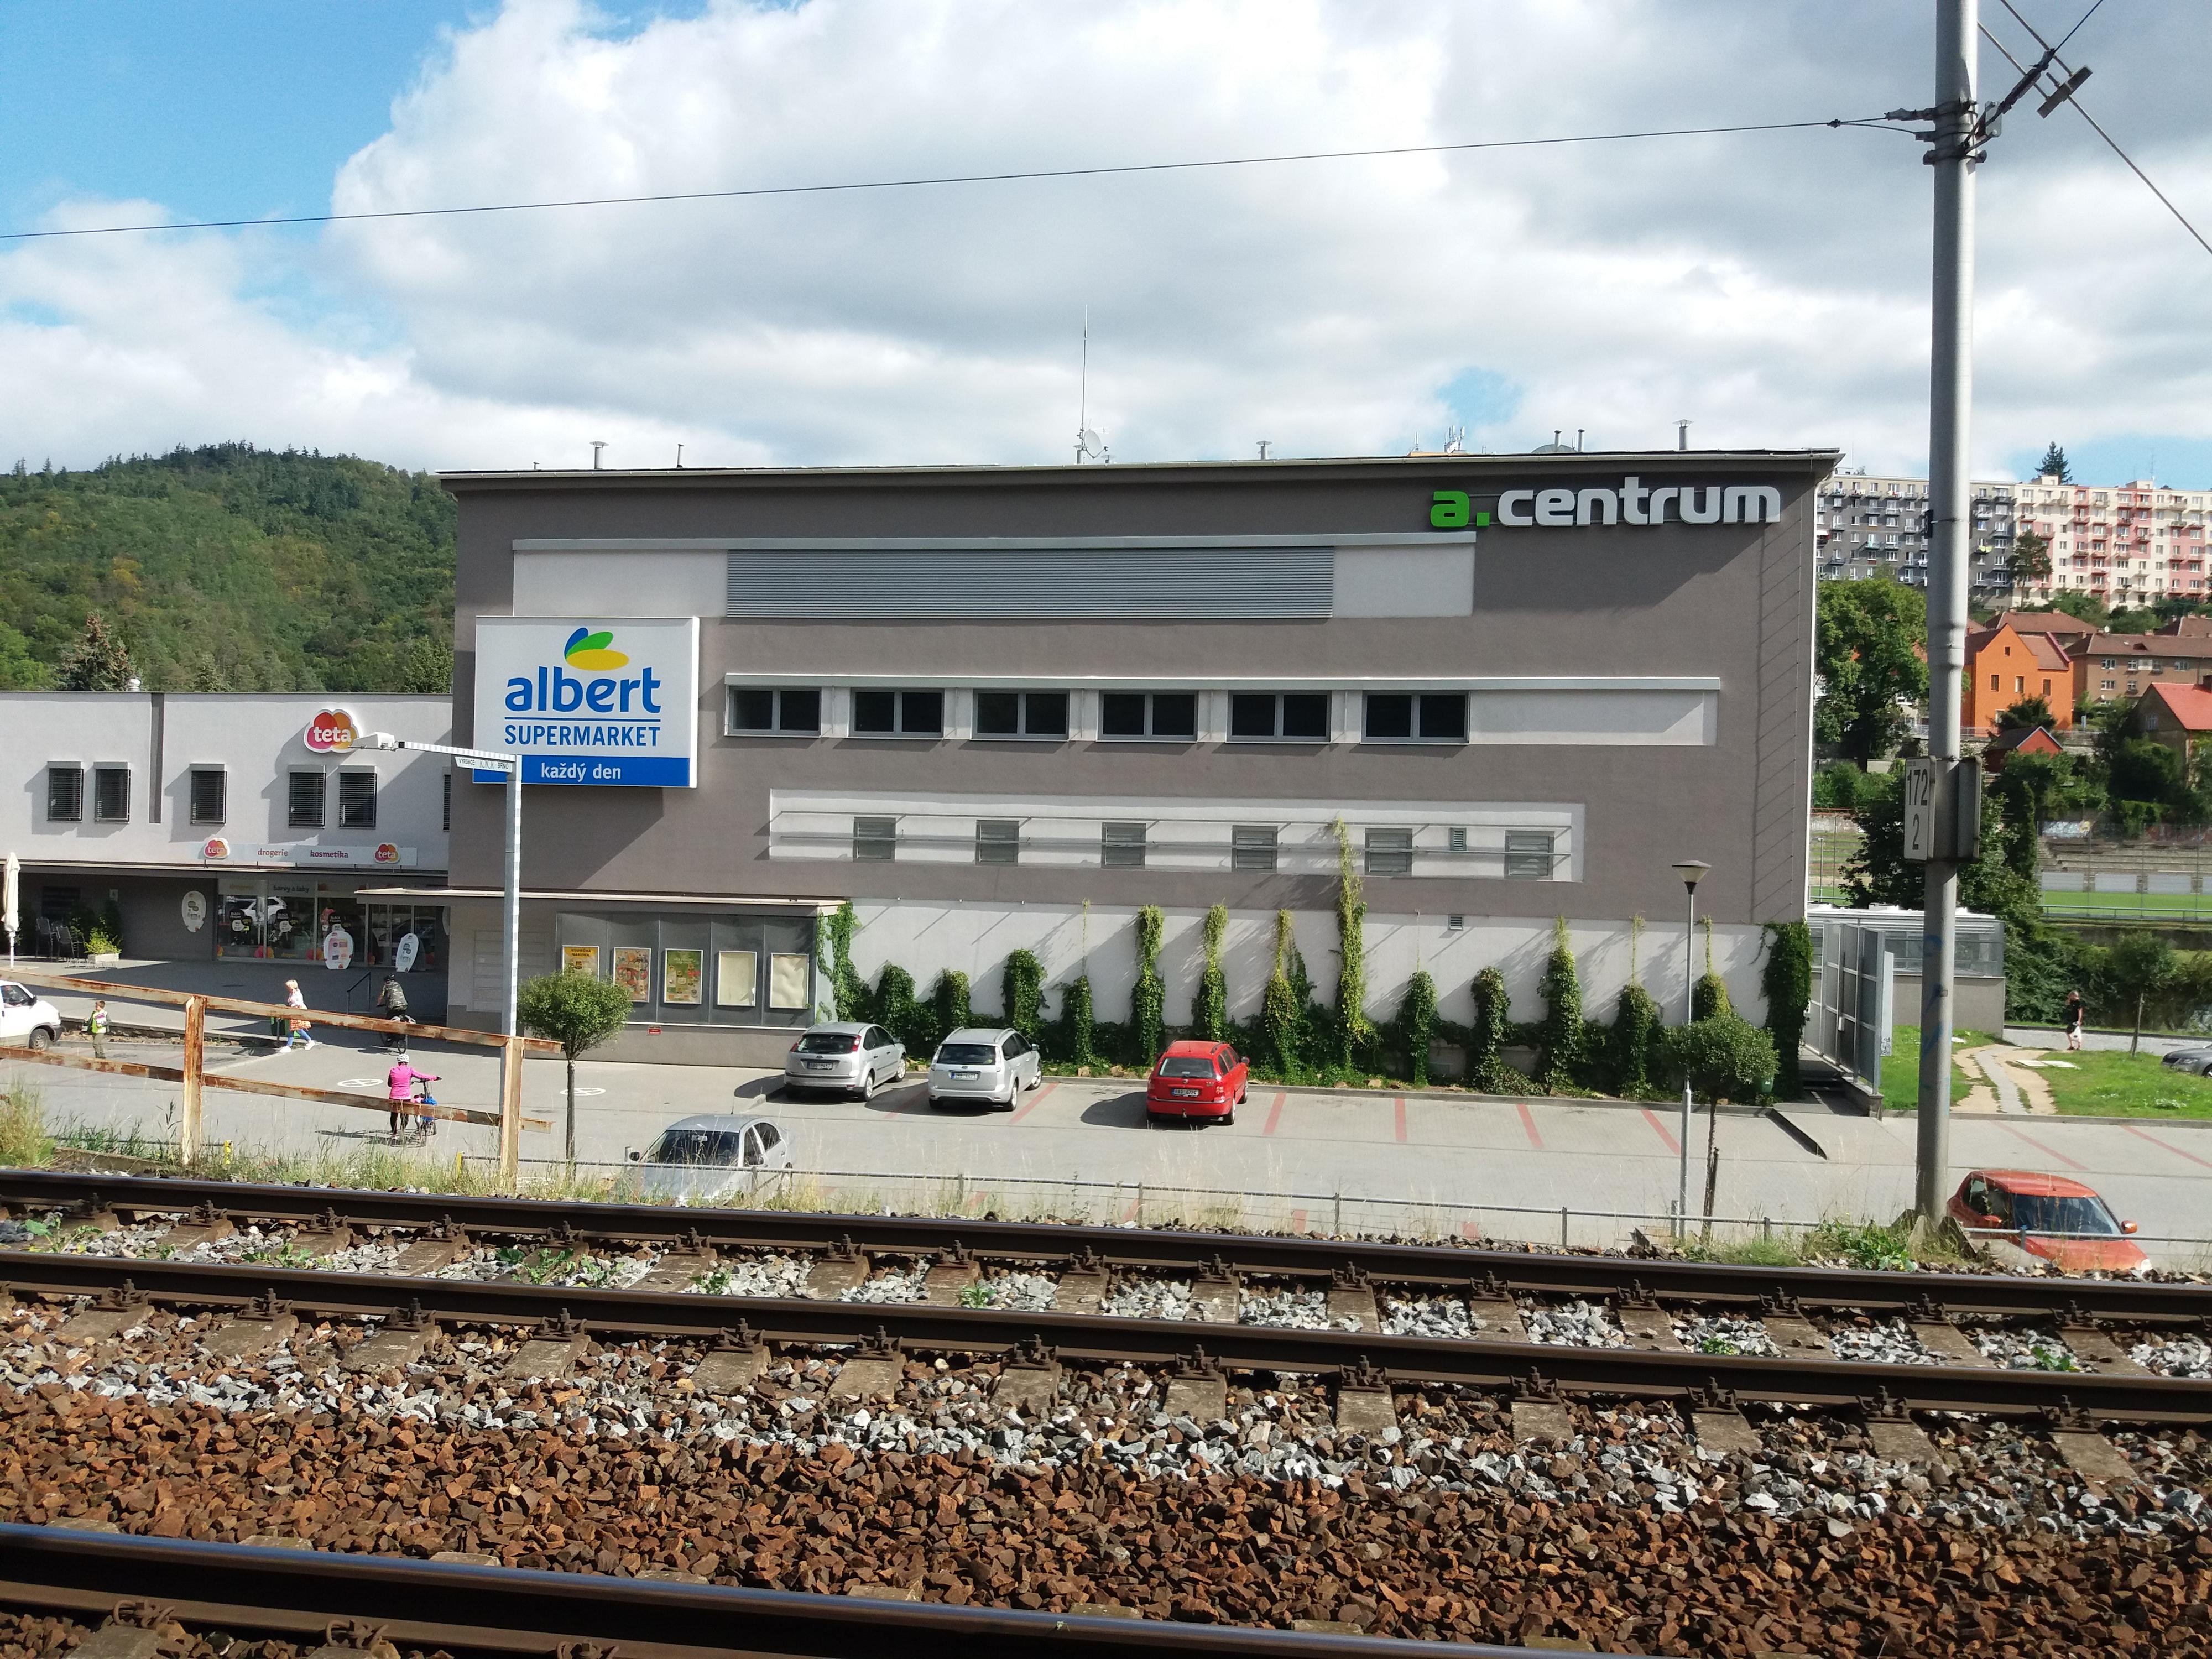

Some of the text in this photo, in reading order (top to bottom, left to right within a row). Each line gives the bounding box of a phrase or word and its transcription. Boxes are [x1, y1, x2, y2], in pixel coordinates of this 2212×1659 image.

[504, 666, 661, 713] albert
[314, 726, 351, 742] teta
[504, 724, 661, 747] SUPERMARKET
[541, 762, 621, 782] každý den
[1907, 769, 1928, 806] 172
[1912, 813, 1919, 850] 2
[258, 848, 348, 858] drogerie kosmetika
